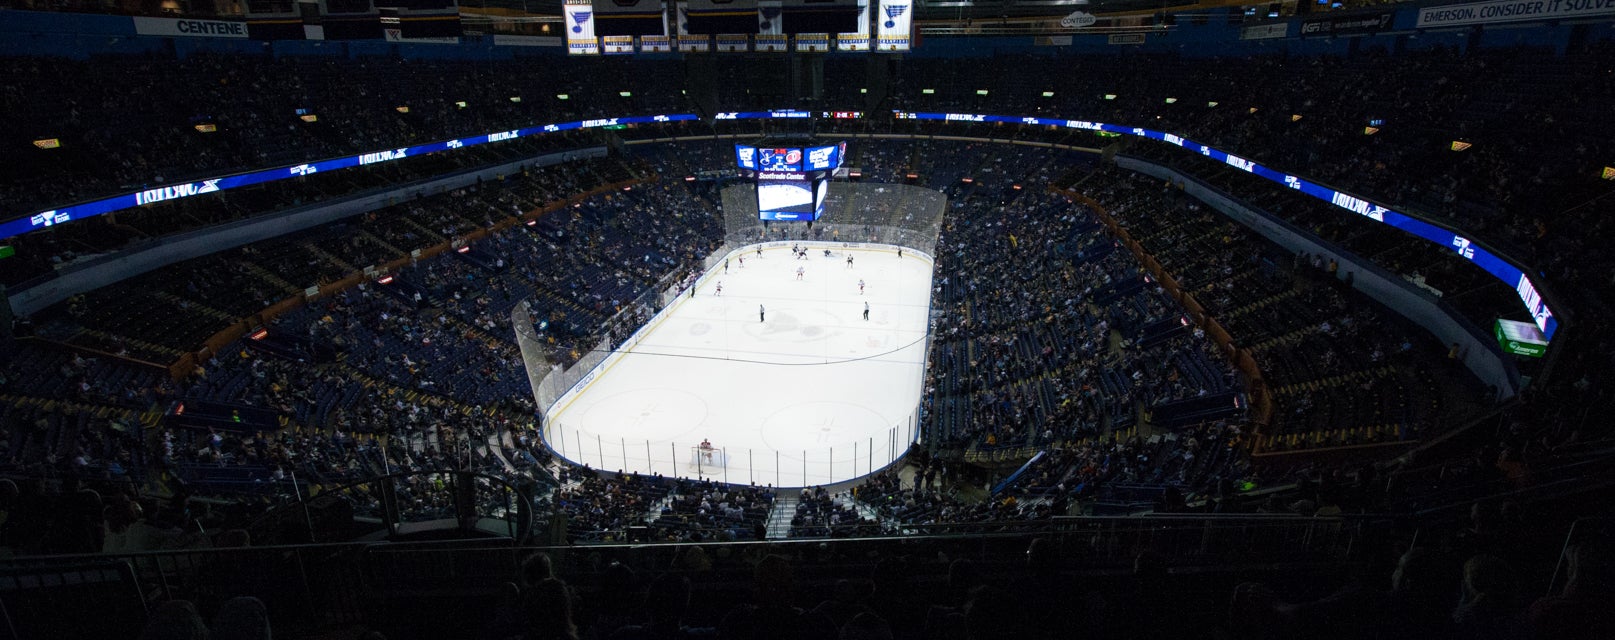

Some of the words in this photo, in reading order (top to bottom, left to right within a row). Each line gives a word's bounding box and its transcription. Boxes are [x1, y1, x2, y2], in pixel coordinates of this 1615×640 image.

[1423, 8, 1476, 23] EMERSON,
[1479, 1, 1543, 18] CONSIDER
[1547, 0, 1560, 13] IT
[177, 20, 243, 35] CENTENE
[786, 172, 805, 180] Center
[575, 372, 595, 393] GEICO
